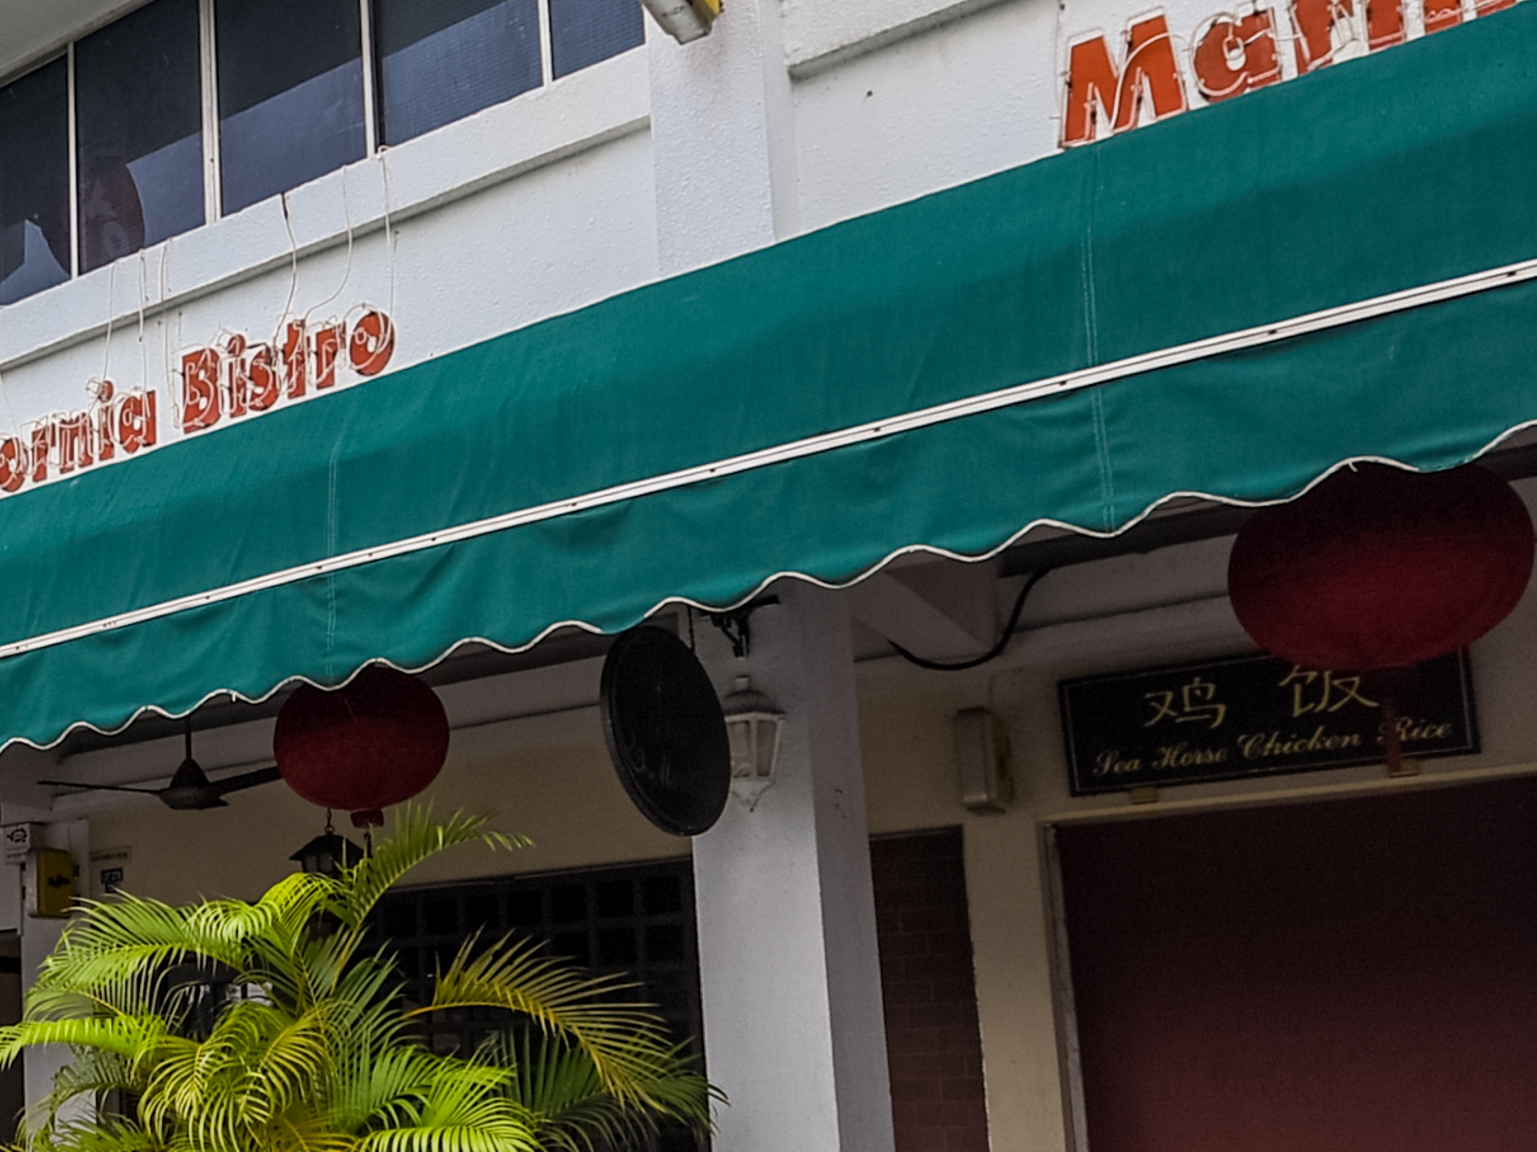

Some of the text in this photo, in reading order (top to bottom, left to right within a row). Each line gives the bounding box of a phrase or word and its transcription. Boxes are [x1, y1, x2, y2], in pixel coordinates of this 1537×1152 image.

[179, 310, 396, 434] Bistro
[1144, 665, 1379, 730] 鸡饭
[1093, 750, 1141, 777] Sea
[1152, 742, 1229, 769] Horse
[1237, 725, 1362, 759] Chicken
